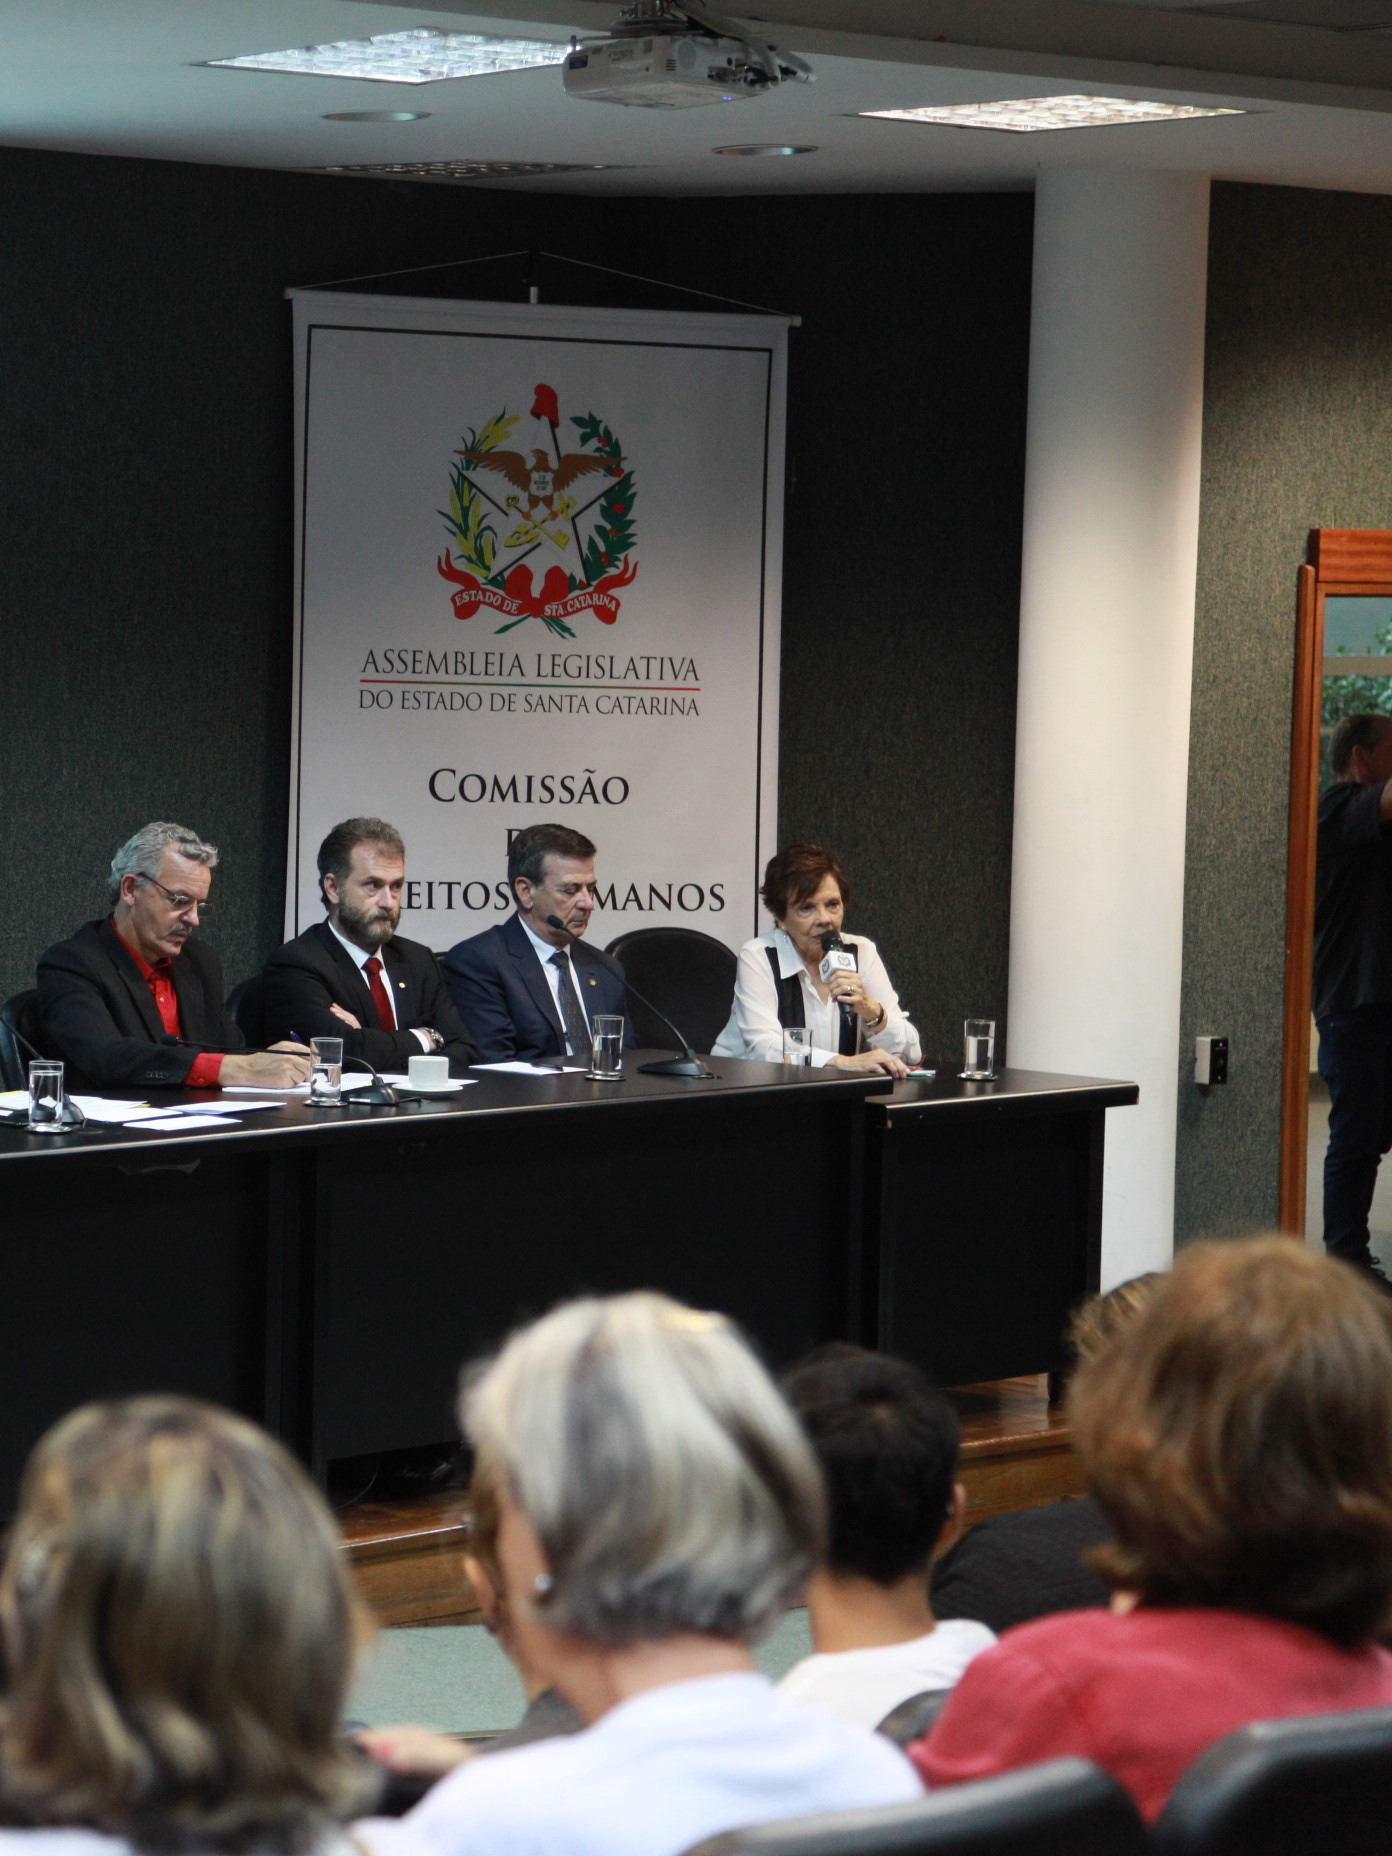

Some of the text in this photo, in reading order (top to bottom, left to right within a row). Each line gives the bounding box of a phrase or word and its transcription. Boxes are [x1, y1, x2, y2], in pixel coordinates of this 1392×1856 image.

[454, 590, 502, 606] ESTADO
[502, 601, 519, 615] DE
[361, 648, 700, 681] ASSEMBLEIA LEGISLATIVA
[359, 689, 700, 716] DO ESTADO DE SANTA CATARINA
[428, 767, 630, 806] COMISSÃO
[401, 881, 725, 912] EITOS MANOS
